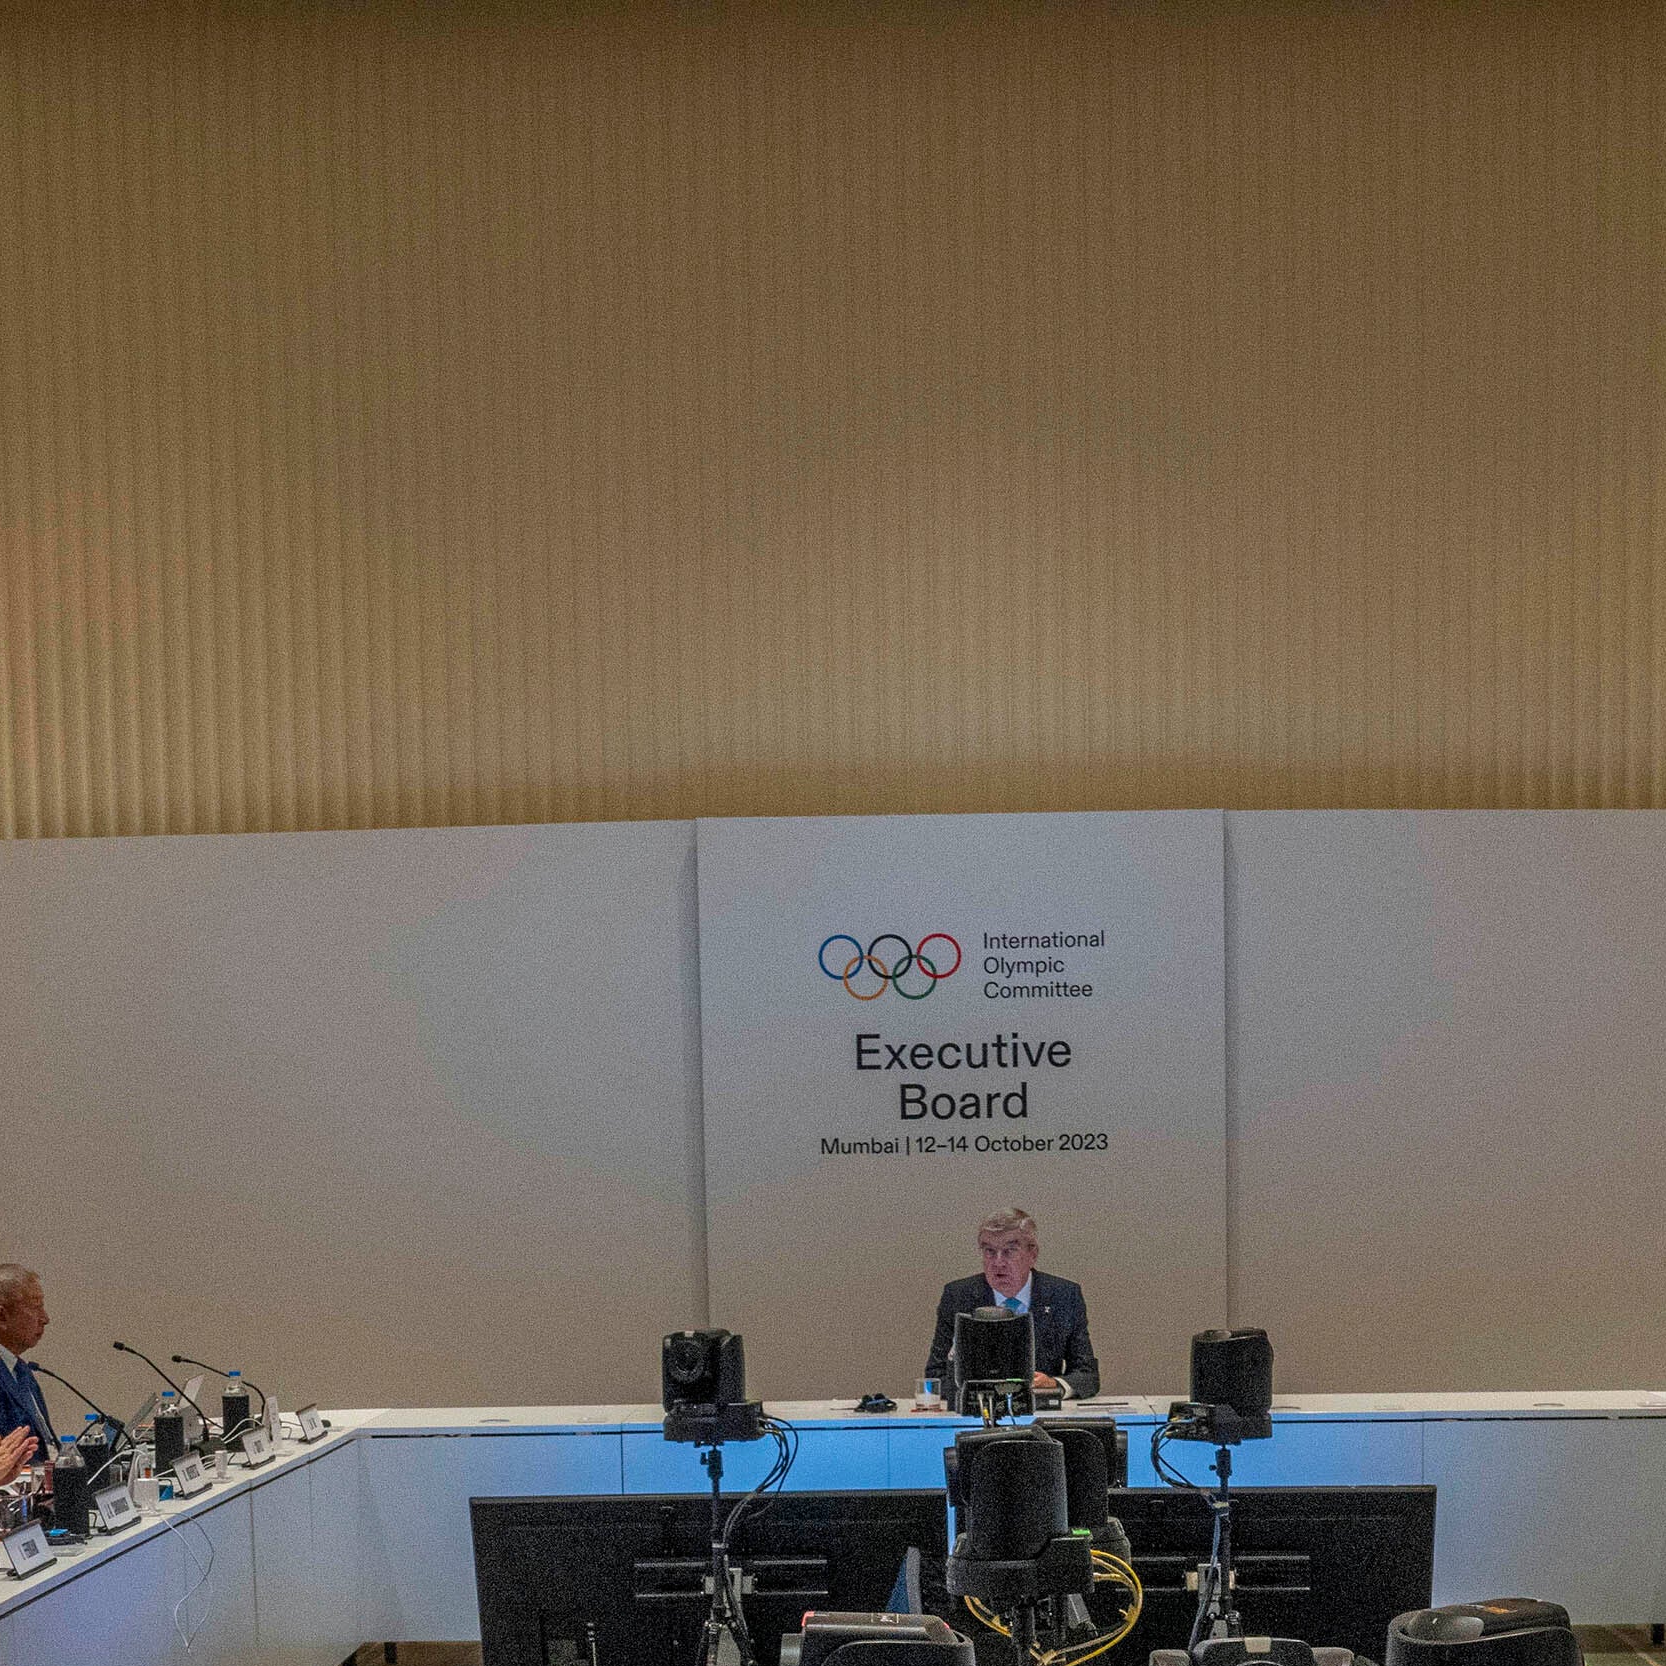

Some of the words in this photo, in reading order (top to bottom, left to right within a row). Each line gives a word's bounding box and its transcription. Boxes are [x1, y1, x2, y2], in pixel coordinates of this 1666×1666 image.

[983, 930, 1105, 949] International
[983, 956, 1065, 978] Olympic
[983, 980, 1093, 999] Committee
[855, 1032, 1072, 1070] Executive
[899, 1082, 1028, 1120] Board
[821, 1136, 900, 1155] Mumbai
[974, 1135, 1054, 1153] October
[1059, 1133, 1109, 1151] 2023
